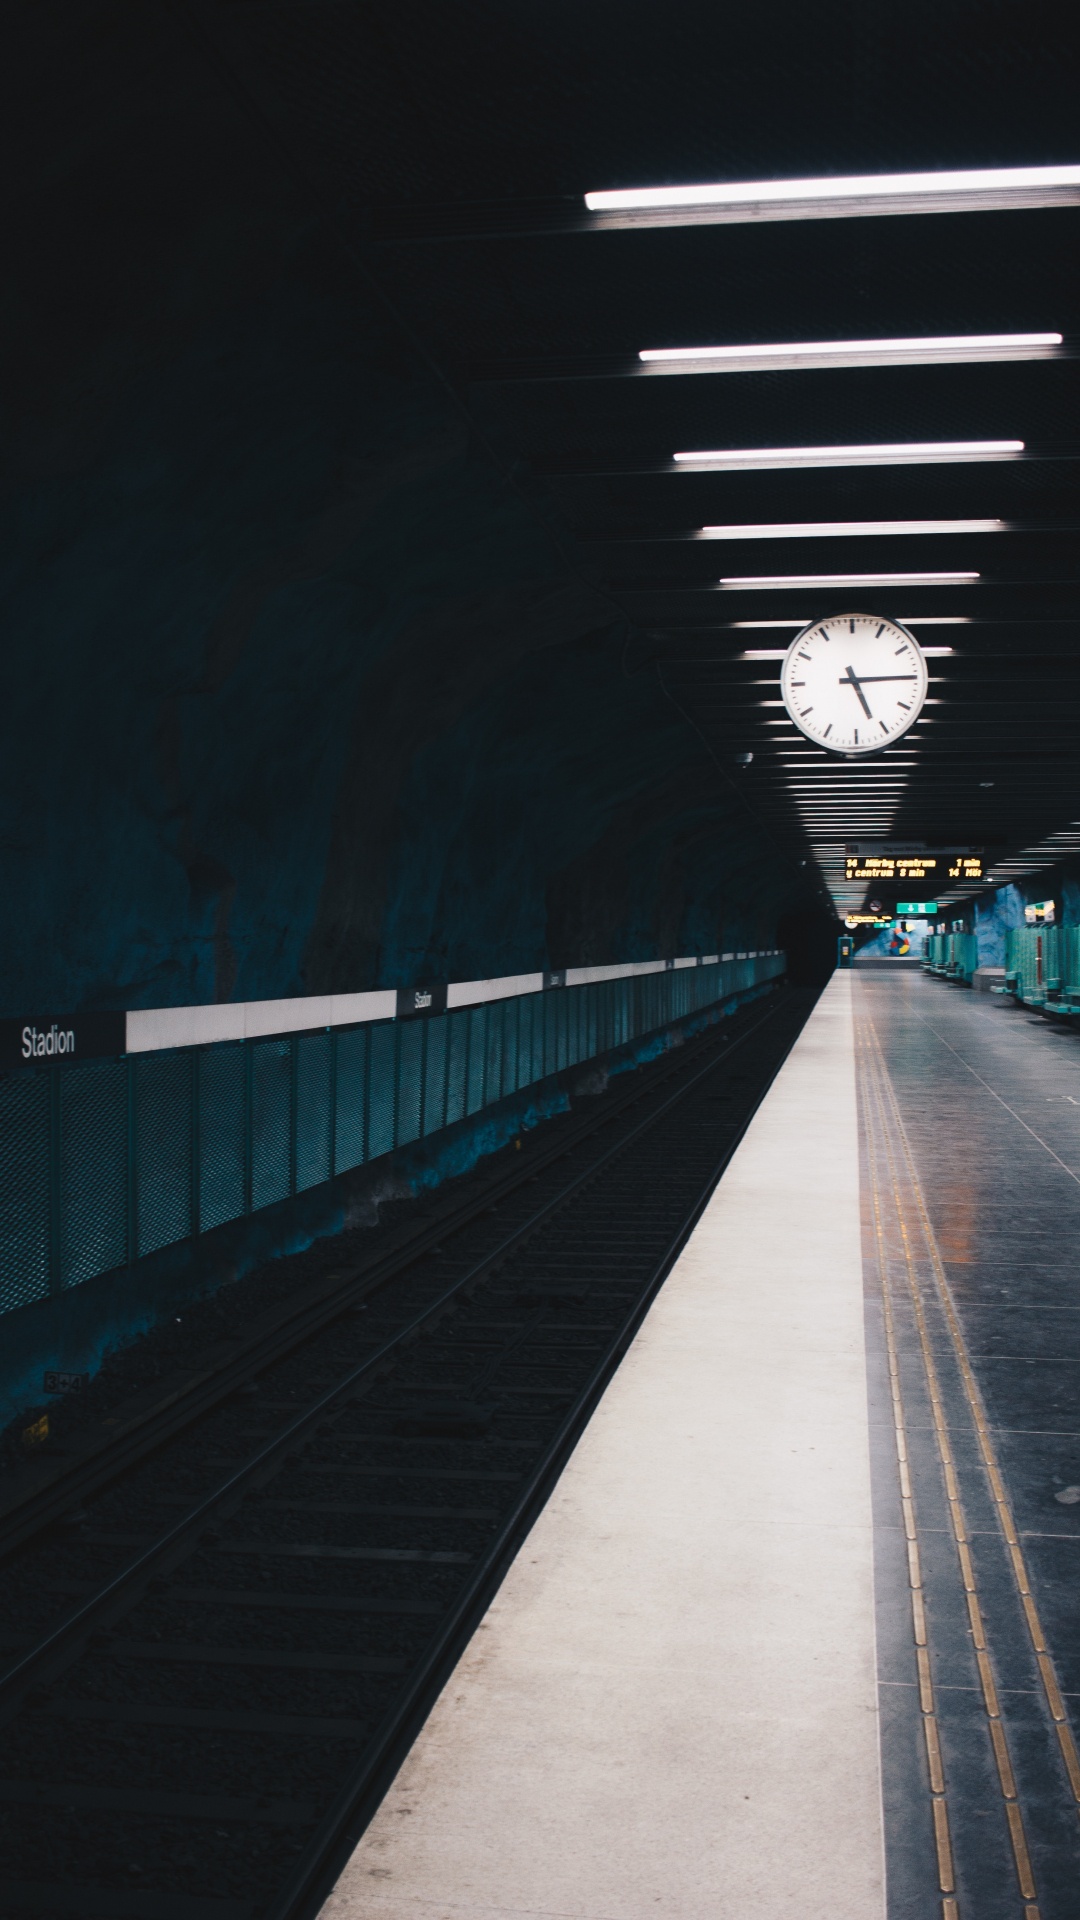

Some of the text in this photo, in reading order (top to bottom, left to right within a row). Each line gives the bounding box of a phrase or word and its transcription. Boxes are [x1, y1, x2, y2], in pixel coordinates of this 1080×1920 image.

[847, 858, 858, 867] 14
[896, 858, 937, 867] centrum
[956, 858, 962, 867] 1
[963, 858, 981, 867] min
[846, 869, 852, 878] y
[854, 868, 894, 877] centrum
[908, 868, 925, 877] min
[949, 868, 959, 877] 14
[965, 868, 982, 877] Mör
[21, 1024, 75, 1058] Stadion
